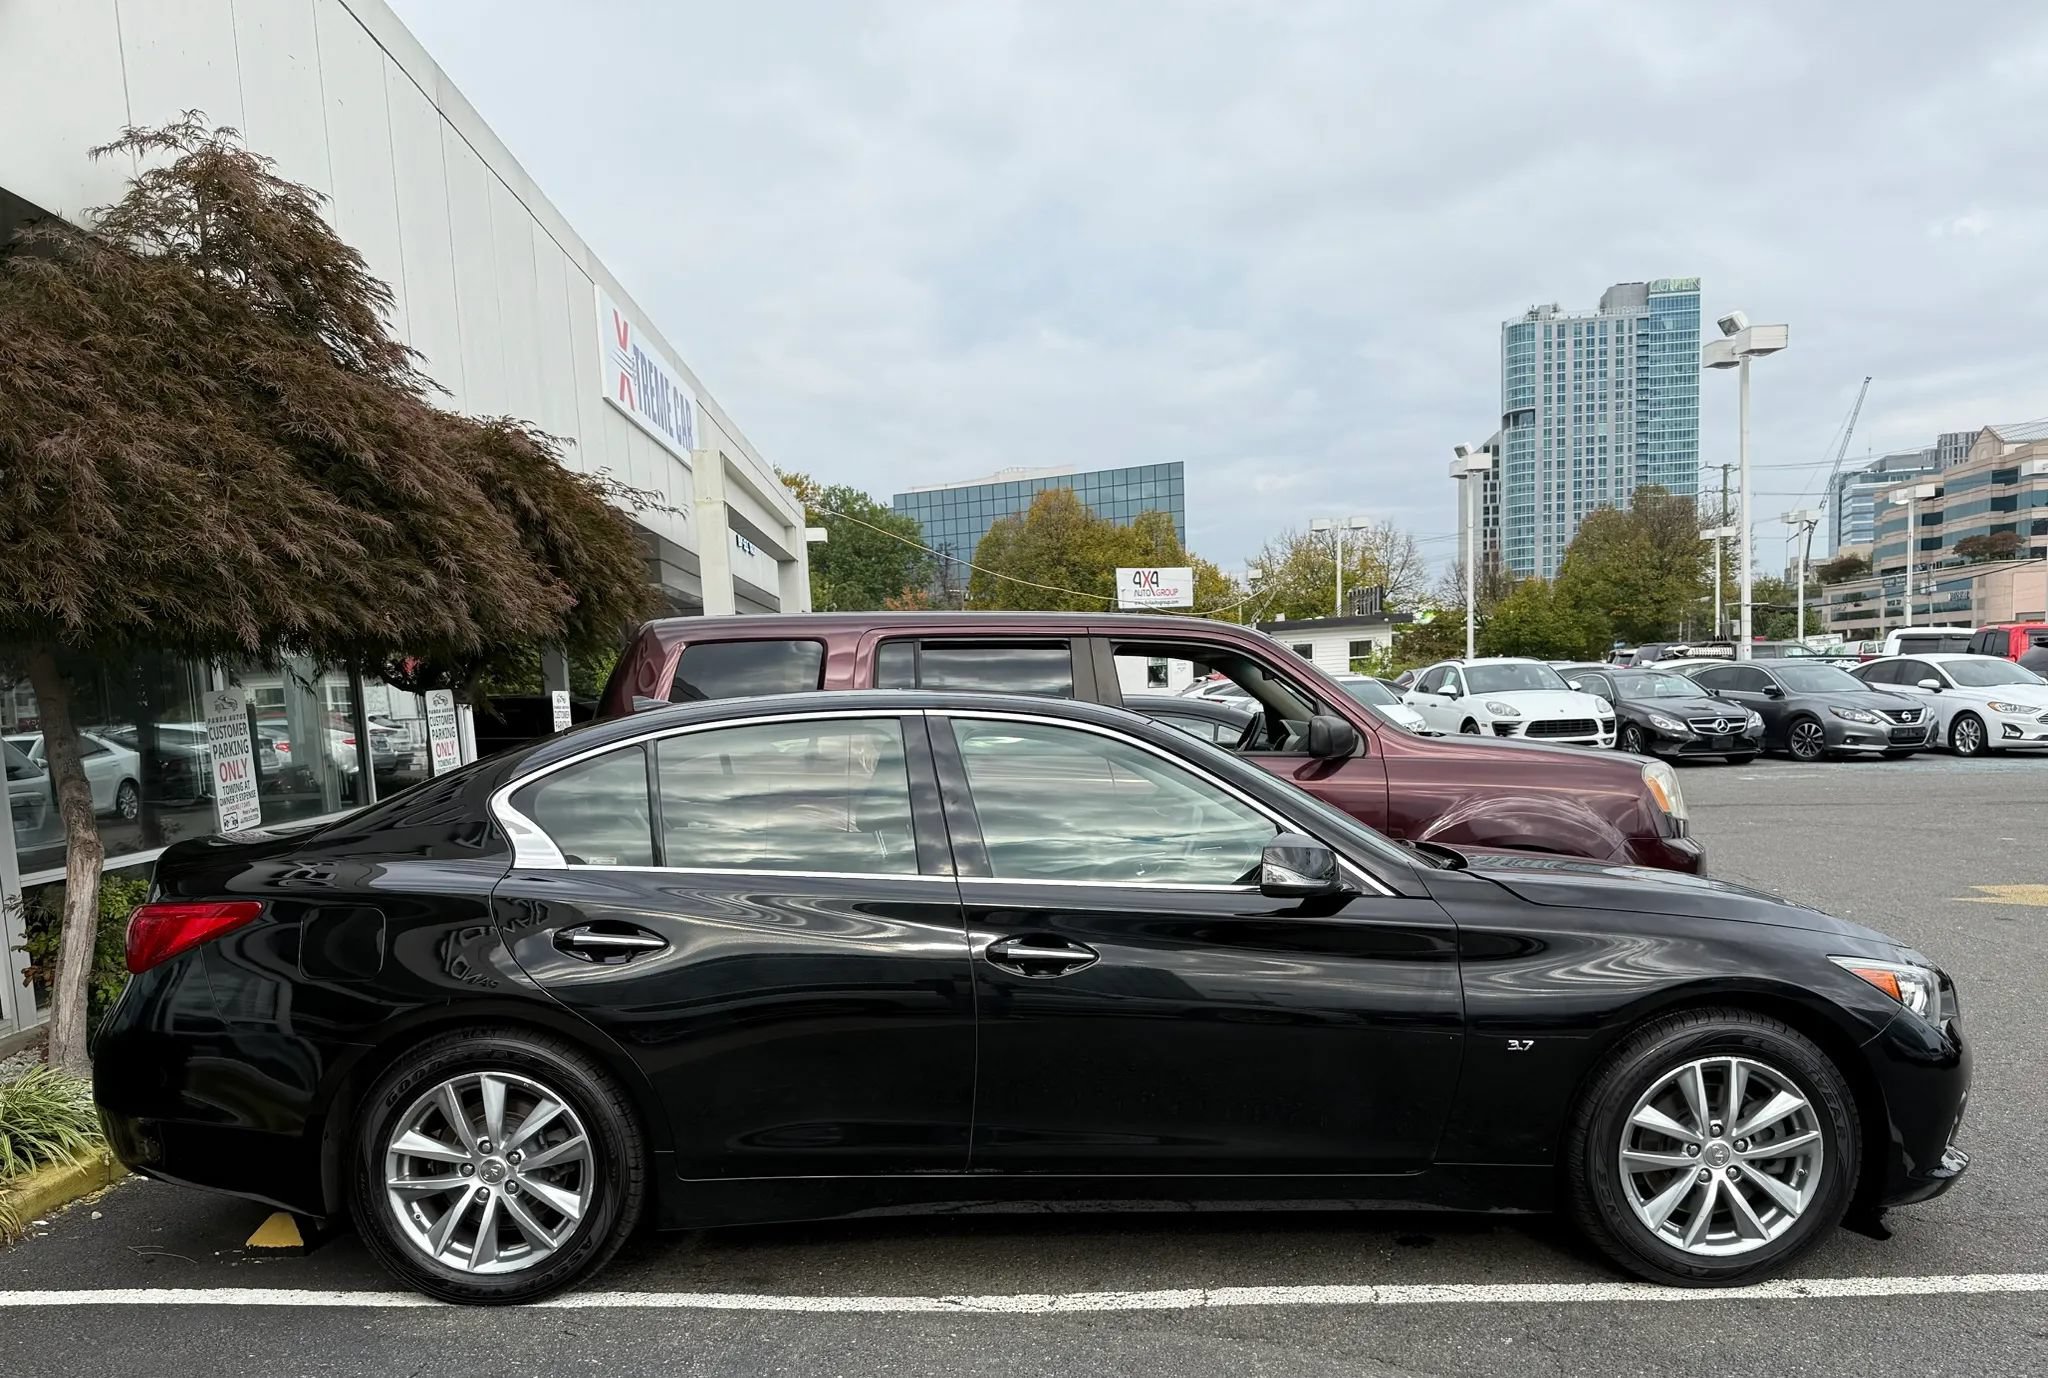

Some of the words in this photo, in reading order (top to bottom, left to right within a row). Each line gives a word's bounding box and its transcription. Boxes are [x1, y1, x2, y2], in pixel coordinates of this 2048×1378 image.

[673, 386, 693, 453] CAR
[1134, 588, 1152, 597] AUTO
[1155, 588, 1179, 597] GROUP
[430, 714, 455, 727] CUSTOMER
[208, 722, 248, 741] CUSTOMER
[432, 726, 456, 740] PARKING
[212, 739, 249, 760] PARKING
[436, 740, 455, 758] ONLY
[219, 758, 248, 783] ONLY
[222, 782, 244, 796] TOWING
[244, 780, 251, 790] AT
[219, 794, 239, 806] OWNER'S
[239, 789, 257, 801] EXPENSE
[1507, 1039, 1535, 1051] 3.7
